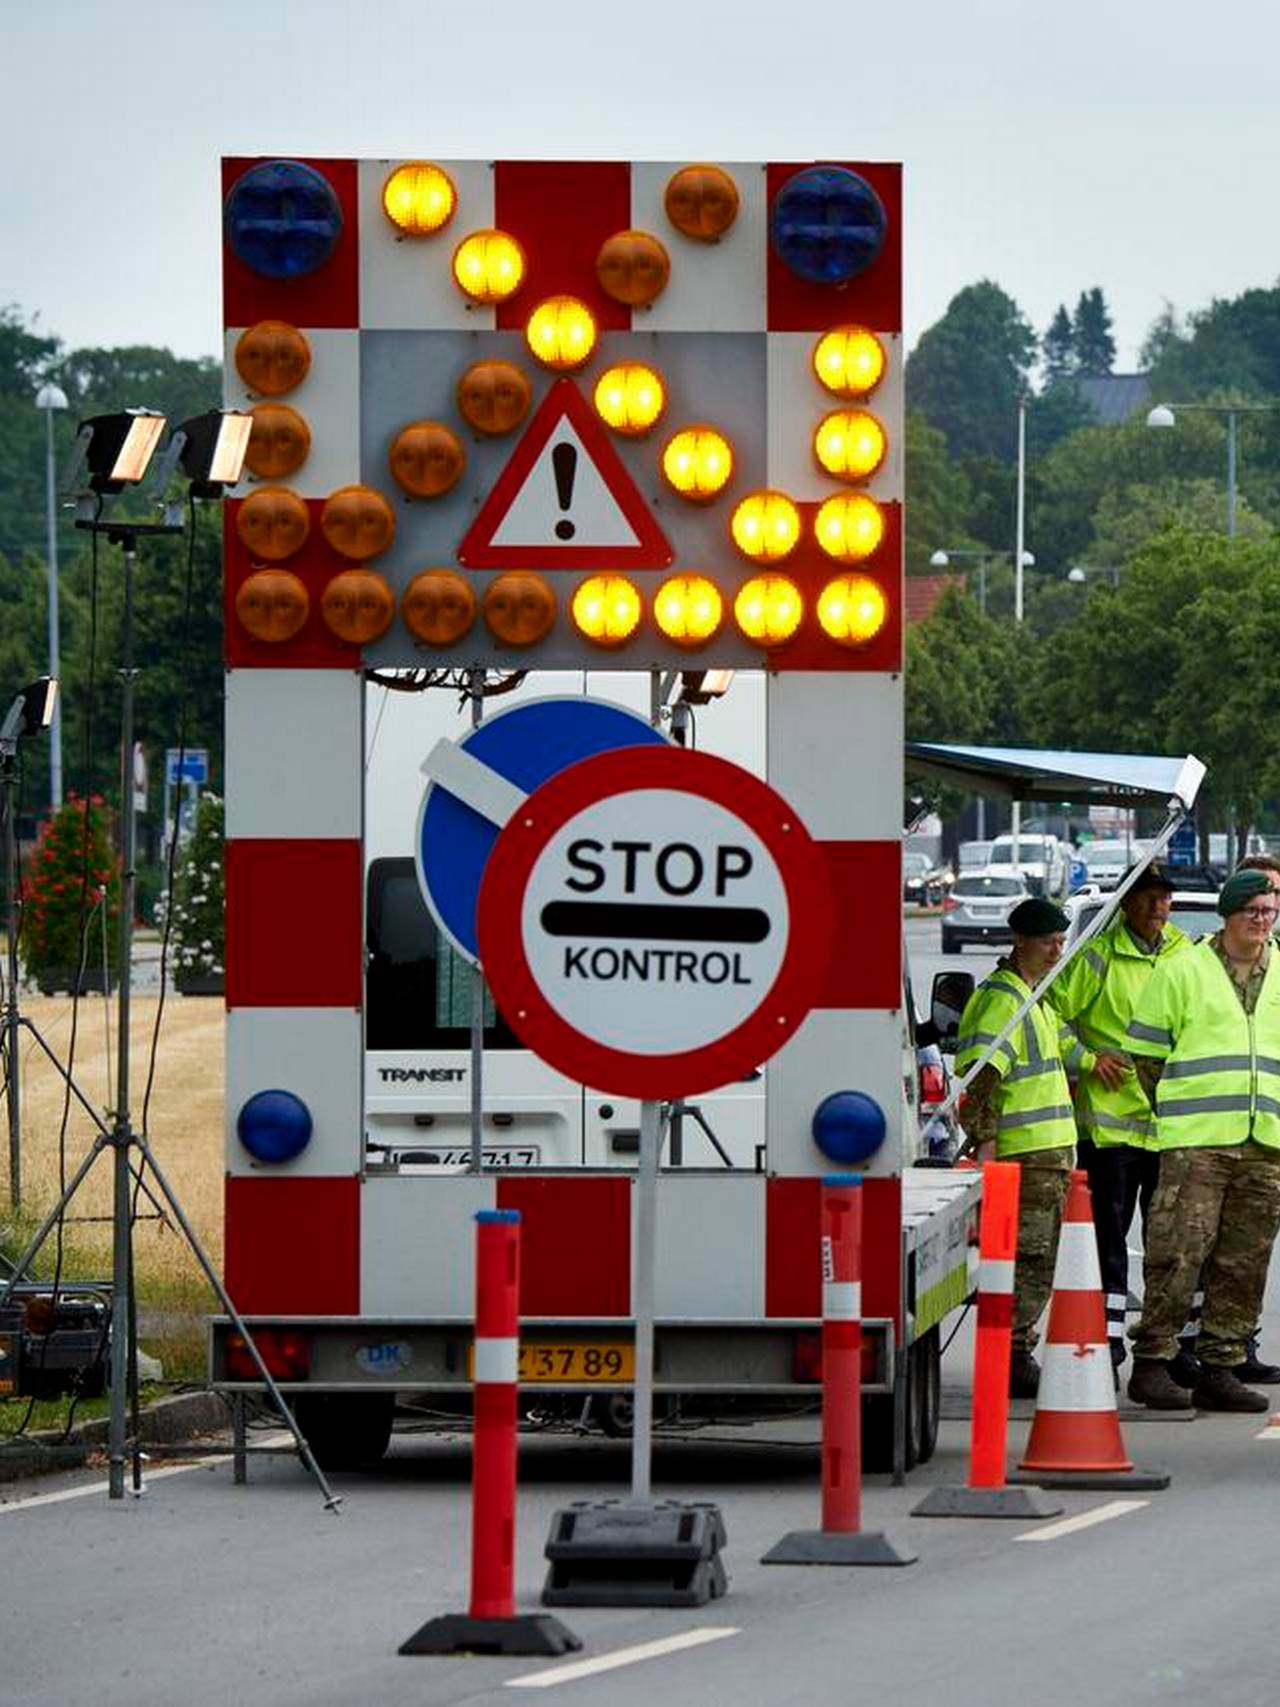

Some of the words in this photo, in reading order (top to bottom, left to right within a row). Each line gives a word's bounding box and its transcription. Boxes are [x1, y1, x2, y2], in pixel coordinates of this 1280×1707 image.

[565, 838, 753, 897] STOP
[564, 946, 751, 984] KONTROL
[378, 1068, 467, 1082] TRANSIT
[368, 1344, 399, 1362] DK
[536, 1349, 575, 1376] 37
[583, 1350, 623, 1377] 89
